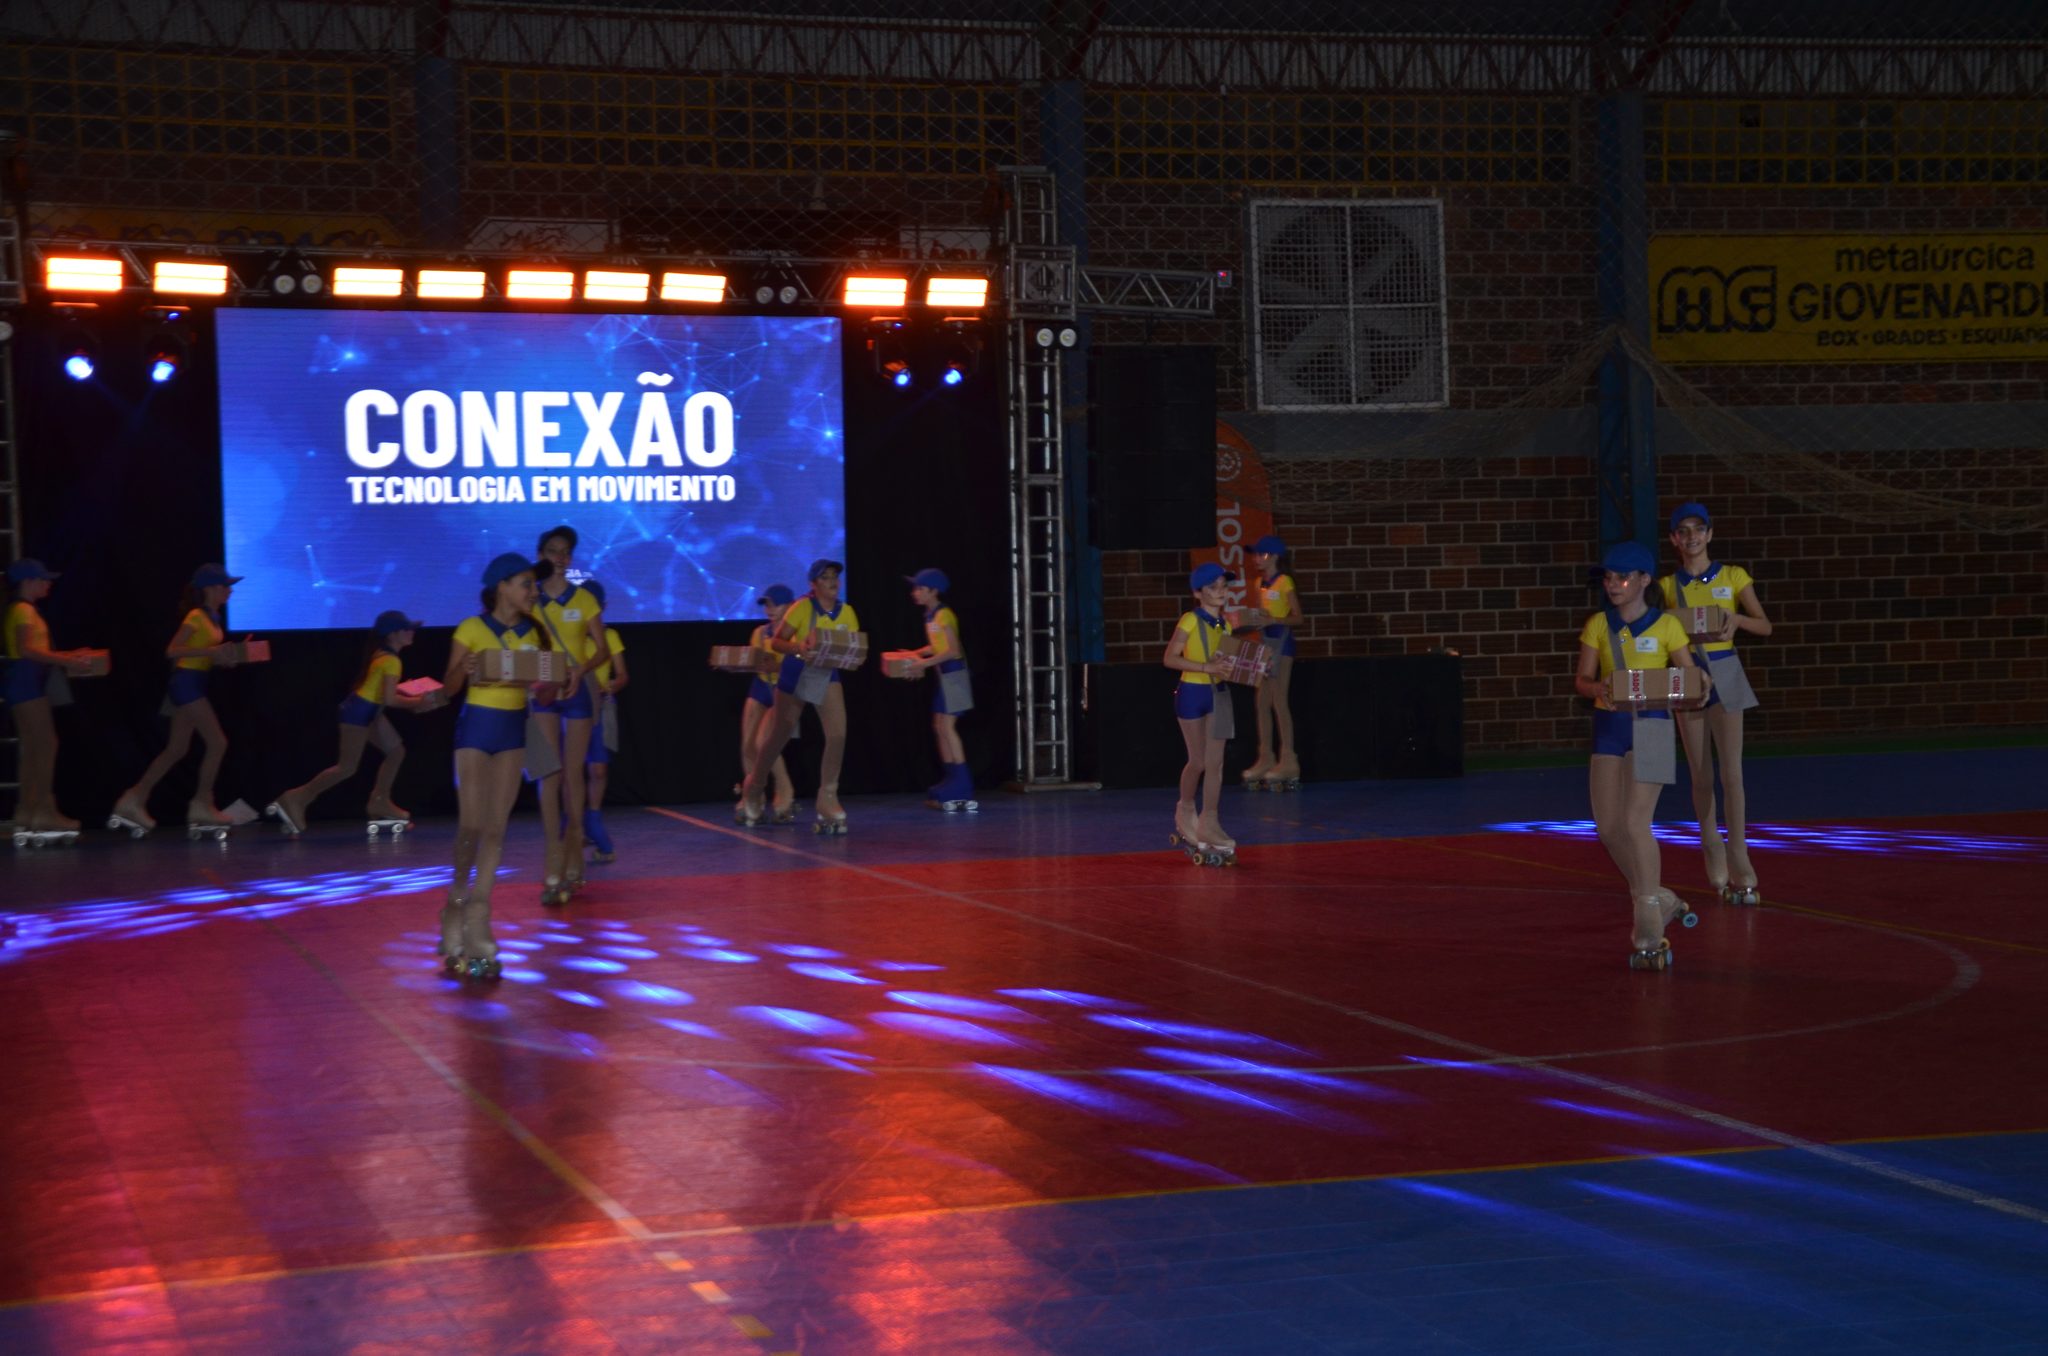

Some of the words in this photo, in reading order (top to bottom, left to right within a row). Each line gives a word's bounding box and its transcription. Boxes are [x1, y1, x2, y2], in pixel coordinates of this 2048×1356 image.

[1816, 330, 1859, 347] BOX
[1871, 328, 1948, 346] GRADES
[344, 371, 735, 468] CONEXÃO
[346, 475, 526, 504] TECNOLOGIA
[531, 475, 571, 503] EM
[577, 474, 736, 502] MOVIMENTO
